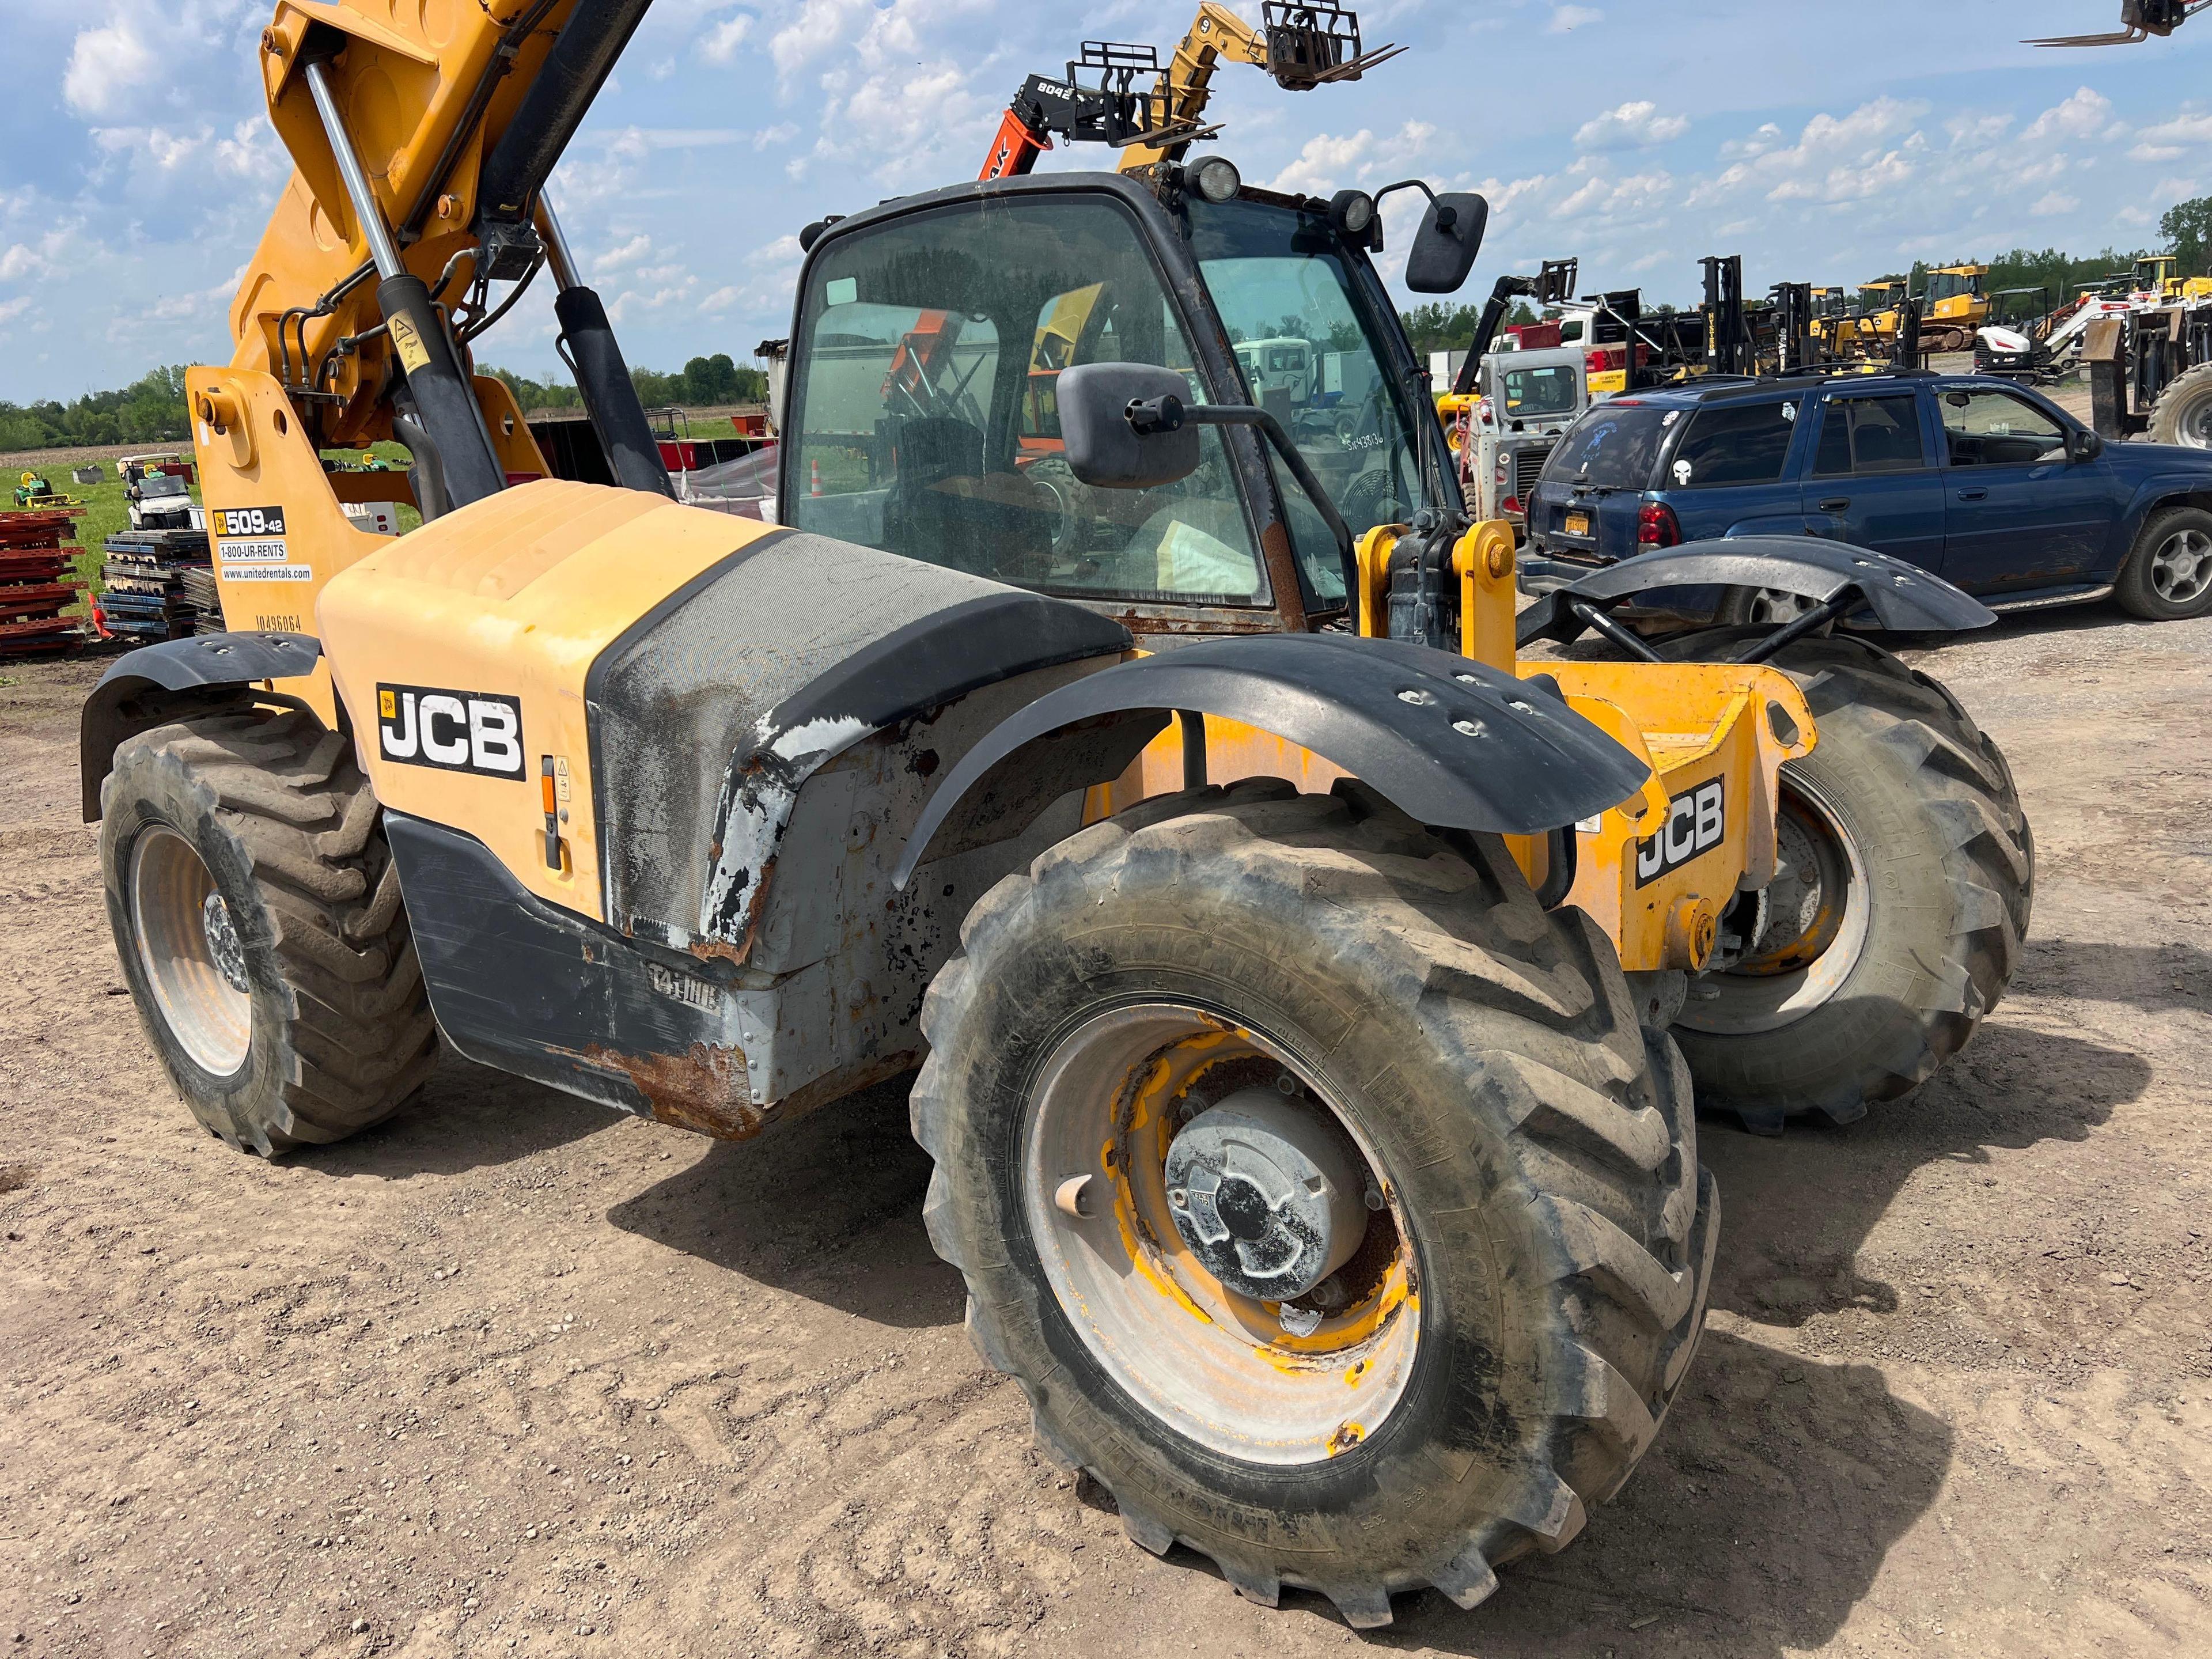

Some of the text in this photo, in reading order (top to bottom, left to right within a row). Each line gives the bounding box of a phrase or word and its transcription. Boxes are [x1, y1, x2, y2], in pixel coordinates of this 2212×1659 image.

[1037, 82, 1071, 101] 8042
[1778, 327, 1787, 350] Yale
[226, 509, 283, 535] 509-42
[221, 543, 285, 558] 1-800-UR-RENTS
[224, 567, 310, 579] www.unitedrentals.com
[256, 614, 301, 632] 10496064
[381, 692, 521, 772] JCB
[1638, 782, 1722, 879] JCB
[1277, 1026, 1327, 1070] TUBELESS
